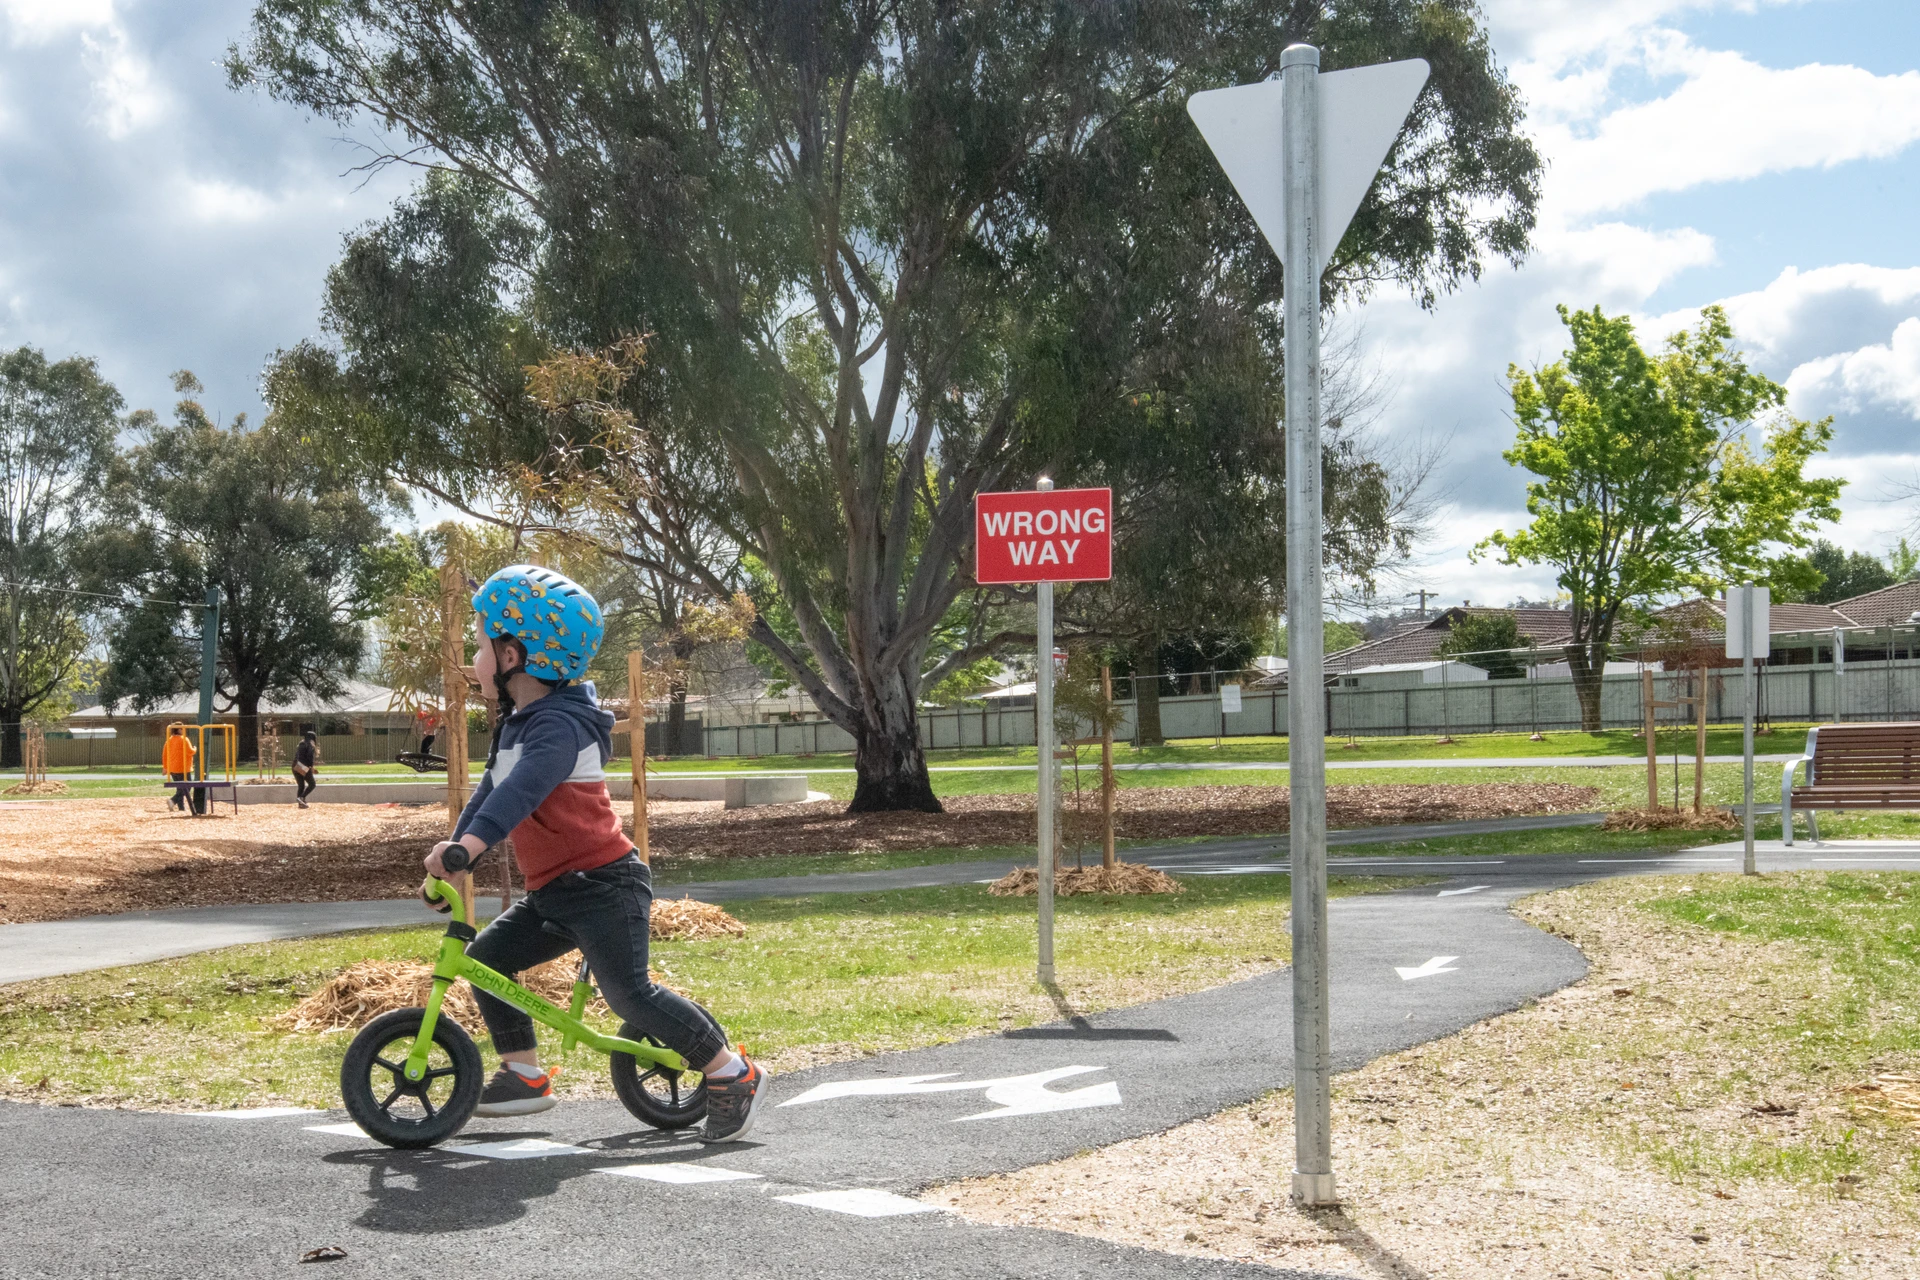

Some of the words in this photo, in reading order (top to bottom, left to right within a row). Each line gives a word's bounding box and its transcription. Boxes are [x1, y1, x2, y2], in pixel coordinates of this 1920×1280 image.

[983, 508, 1105, 537] WRONG
[1008, 539, 1081, 566] WAY
[466, 963, 505, 991] JOHN
[505, 983, 550, 1016] DEERE
